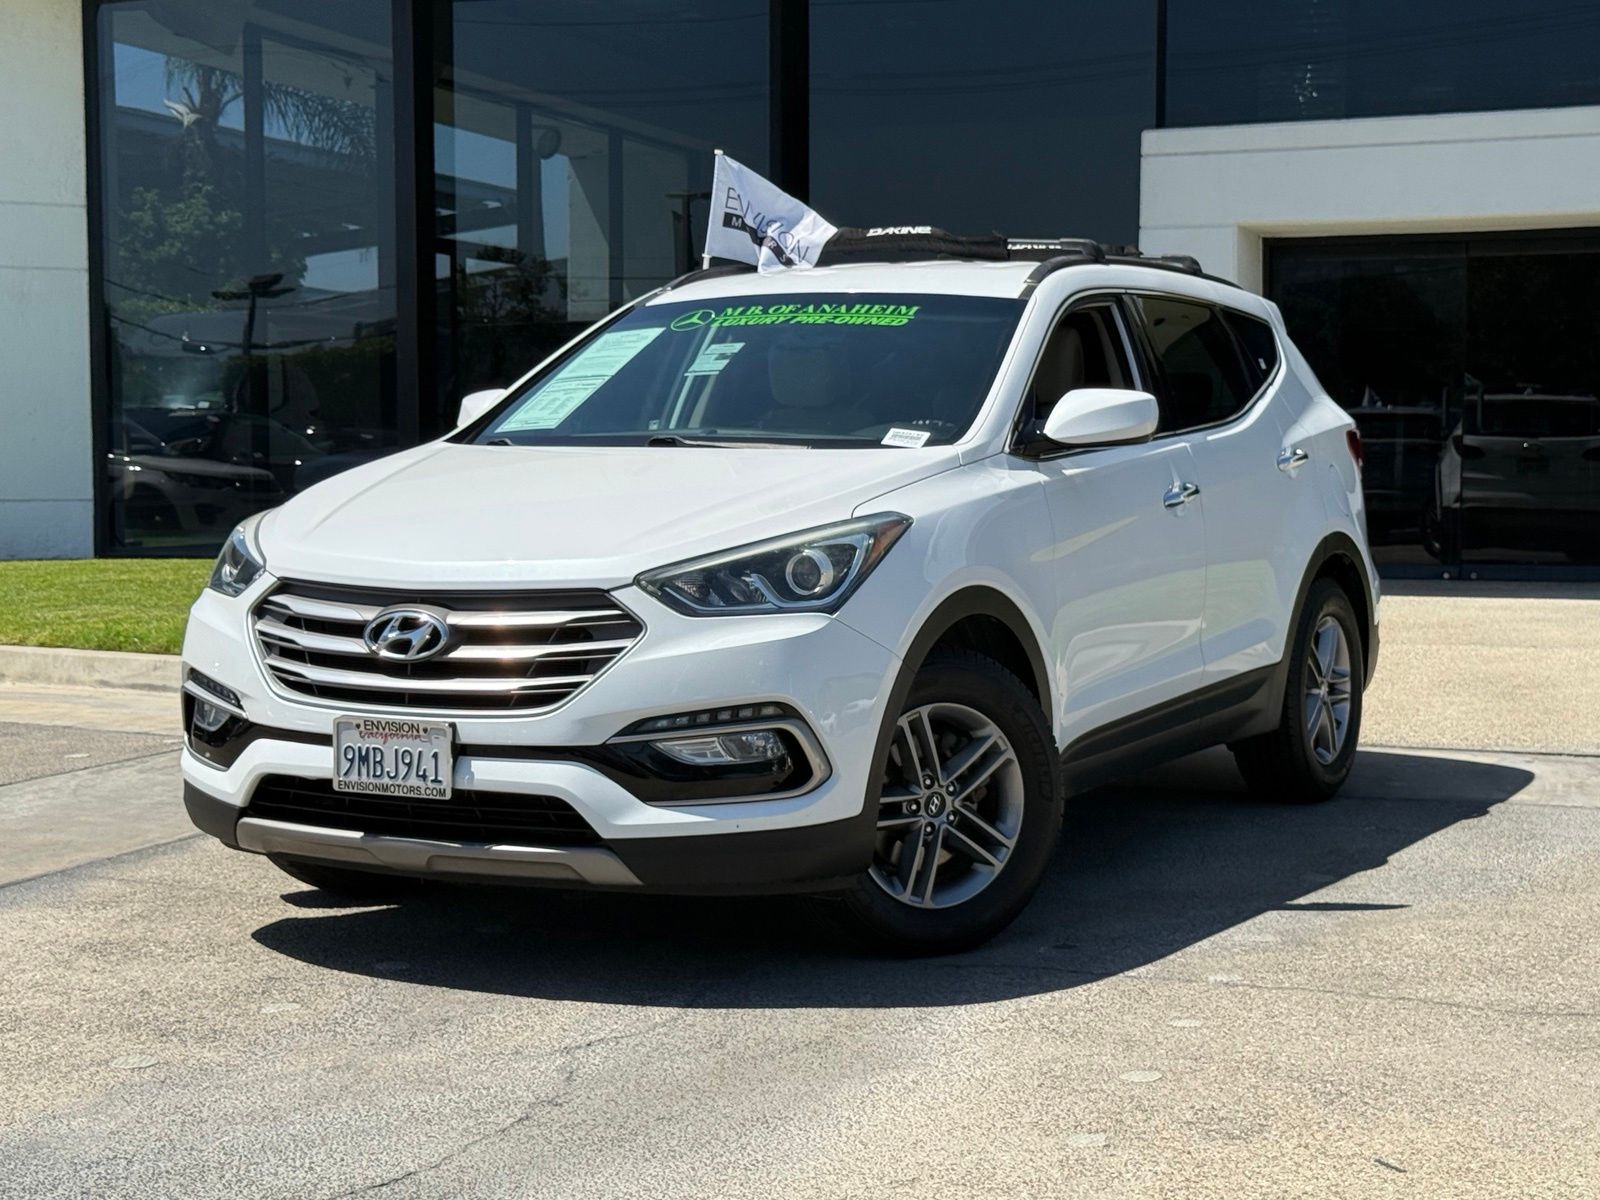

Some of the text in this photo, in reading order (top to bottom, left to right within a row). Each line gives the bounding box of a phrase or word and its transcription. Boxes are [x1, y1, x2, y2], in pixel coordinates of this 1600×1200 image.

[866, 226, 931, 237] DAKINE
[768, 304, 801, 314] OF
[798, 304, 921, 316] ANAHEIM
[711, 316, 910, 328] LUXURY PRE-OWNED
[363, 720, 420, 734] ENVISION
[343, 745, 443, 784] 9MBJ941
[337, 780, 447, 798] ENVISIONMOTORS.COM
